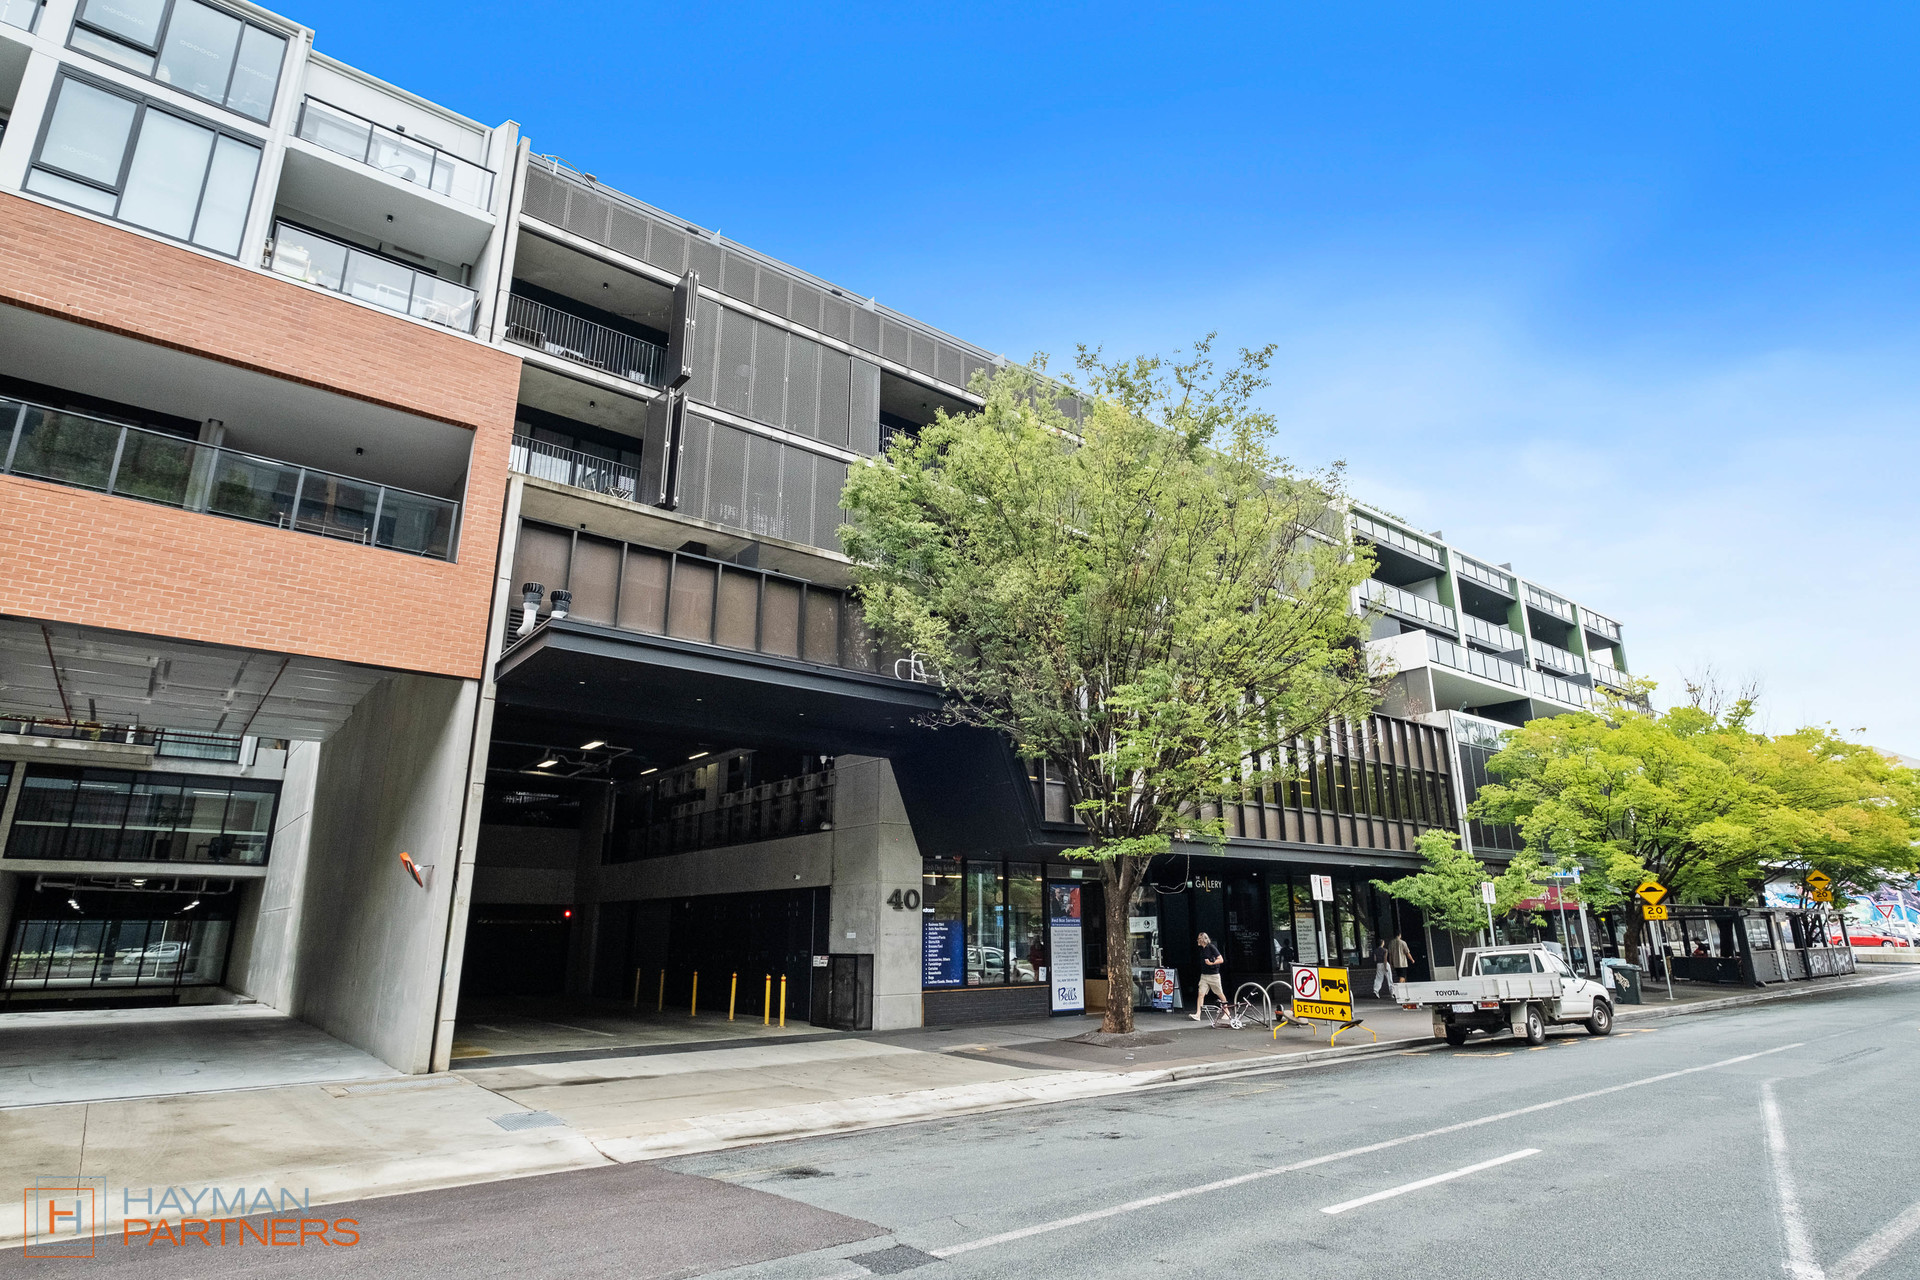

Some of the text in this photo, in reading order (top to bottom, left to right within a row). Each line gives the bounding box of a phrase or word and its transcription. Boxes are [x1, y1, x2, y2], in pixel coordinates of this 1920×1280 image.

[1195, 876, 1222, 892] GALLERY
[886, 888, 920, 910] 40
[1058, 987, 1078, 1001] Bell's
[1297, 1004, 1334, 1015] DETOUR
